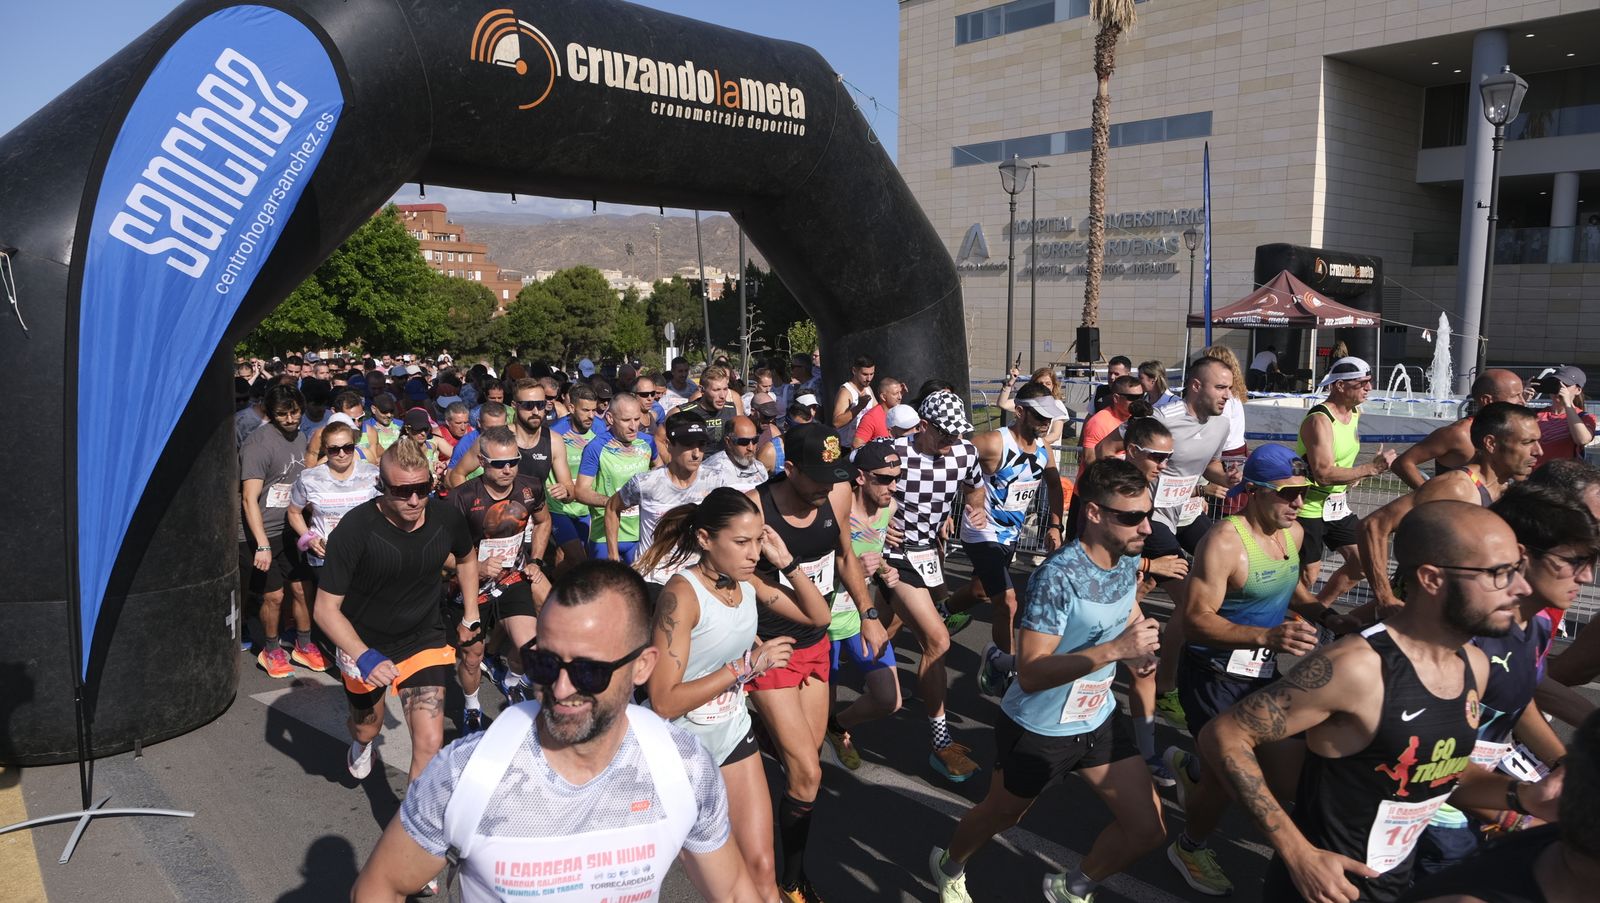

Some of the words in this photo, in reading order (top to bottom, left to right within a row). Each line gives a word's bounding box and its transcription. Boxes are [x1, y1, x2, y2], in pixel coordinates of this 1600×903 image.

[651, 100, 745, 128] cronometraje
[747, 114, 806, 137] deportivo
[215, 111, 335, 295] centrohogarsanchez.es
[1431, 737, 1457, 762] GO
[495, 861, 506, 876] II
[510, 856, 583, 878] CARRERA
[586, 851, 613, 869] SIN
[617, 843, 656, 865] HUMO
